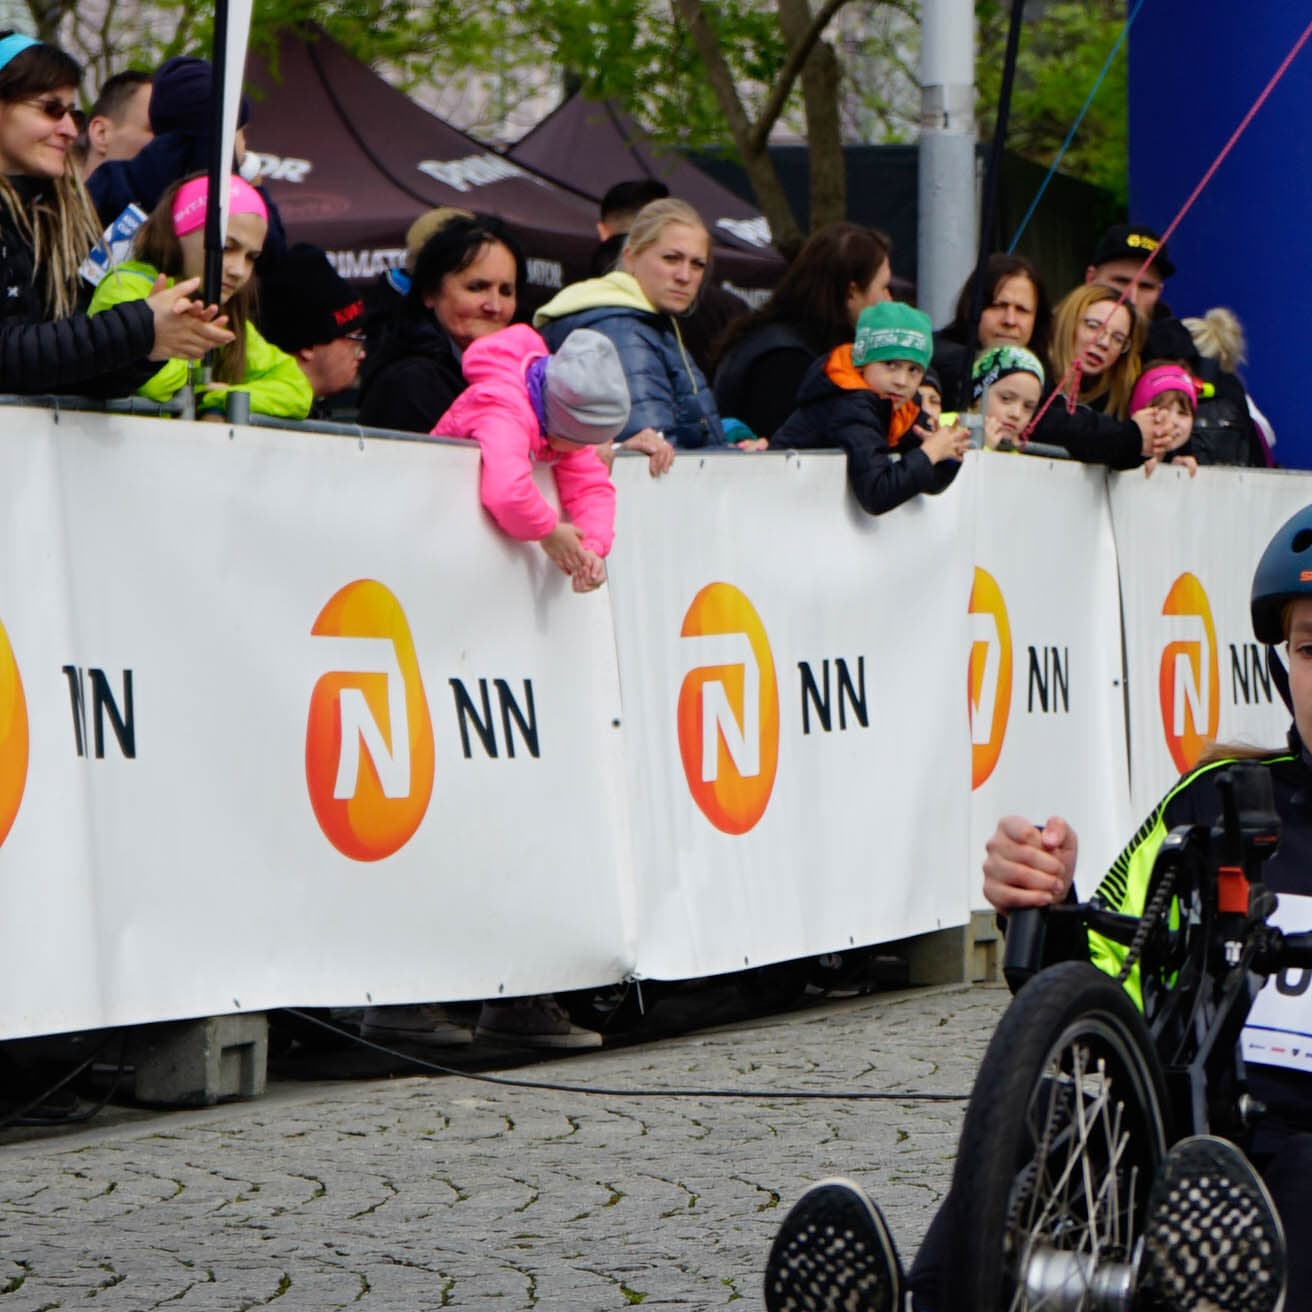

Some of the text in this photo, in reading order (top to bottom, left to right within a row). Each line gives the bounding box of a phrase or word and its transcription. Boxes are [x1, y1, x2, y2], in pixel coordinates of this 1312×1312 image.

[448, 678, 541, 759] NN
[797, 655, 870, 736] NN
[1027, 645, 1070, 714] NN
